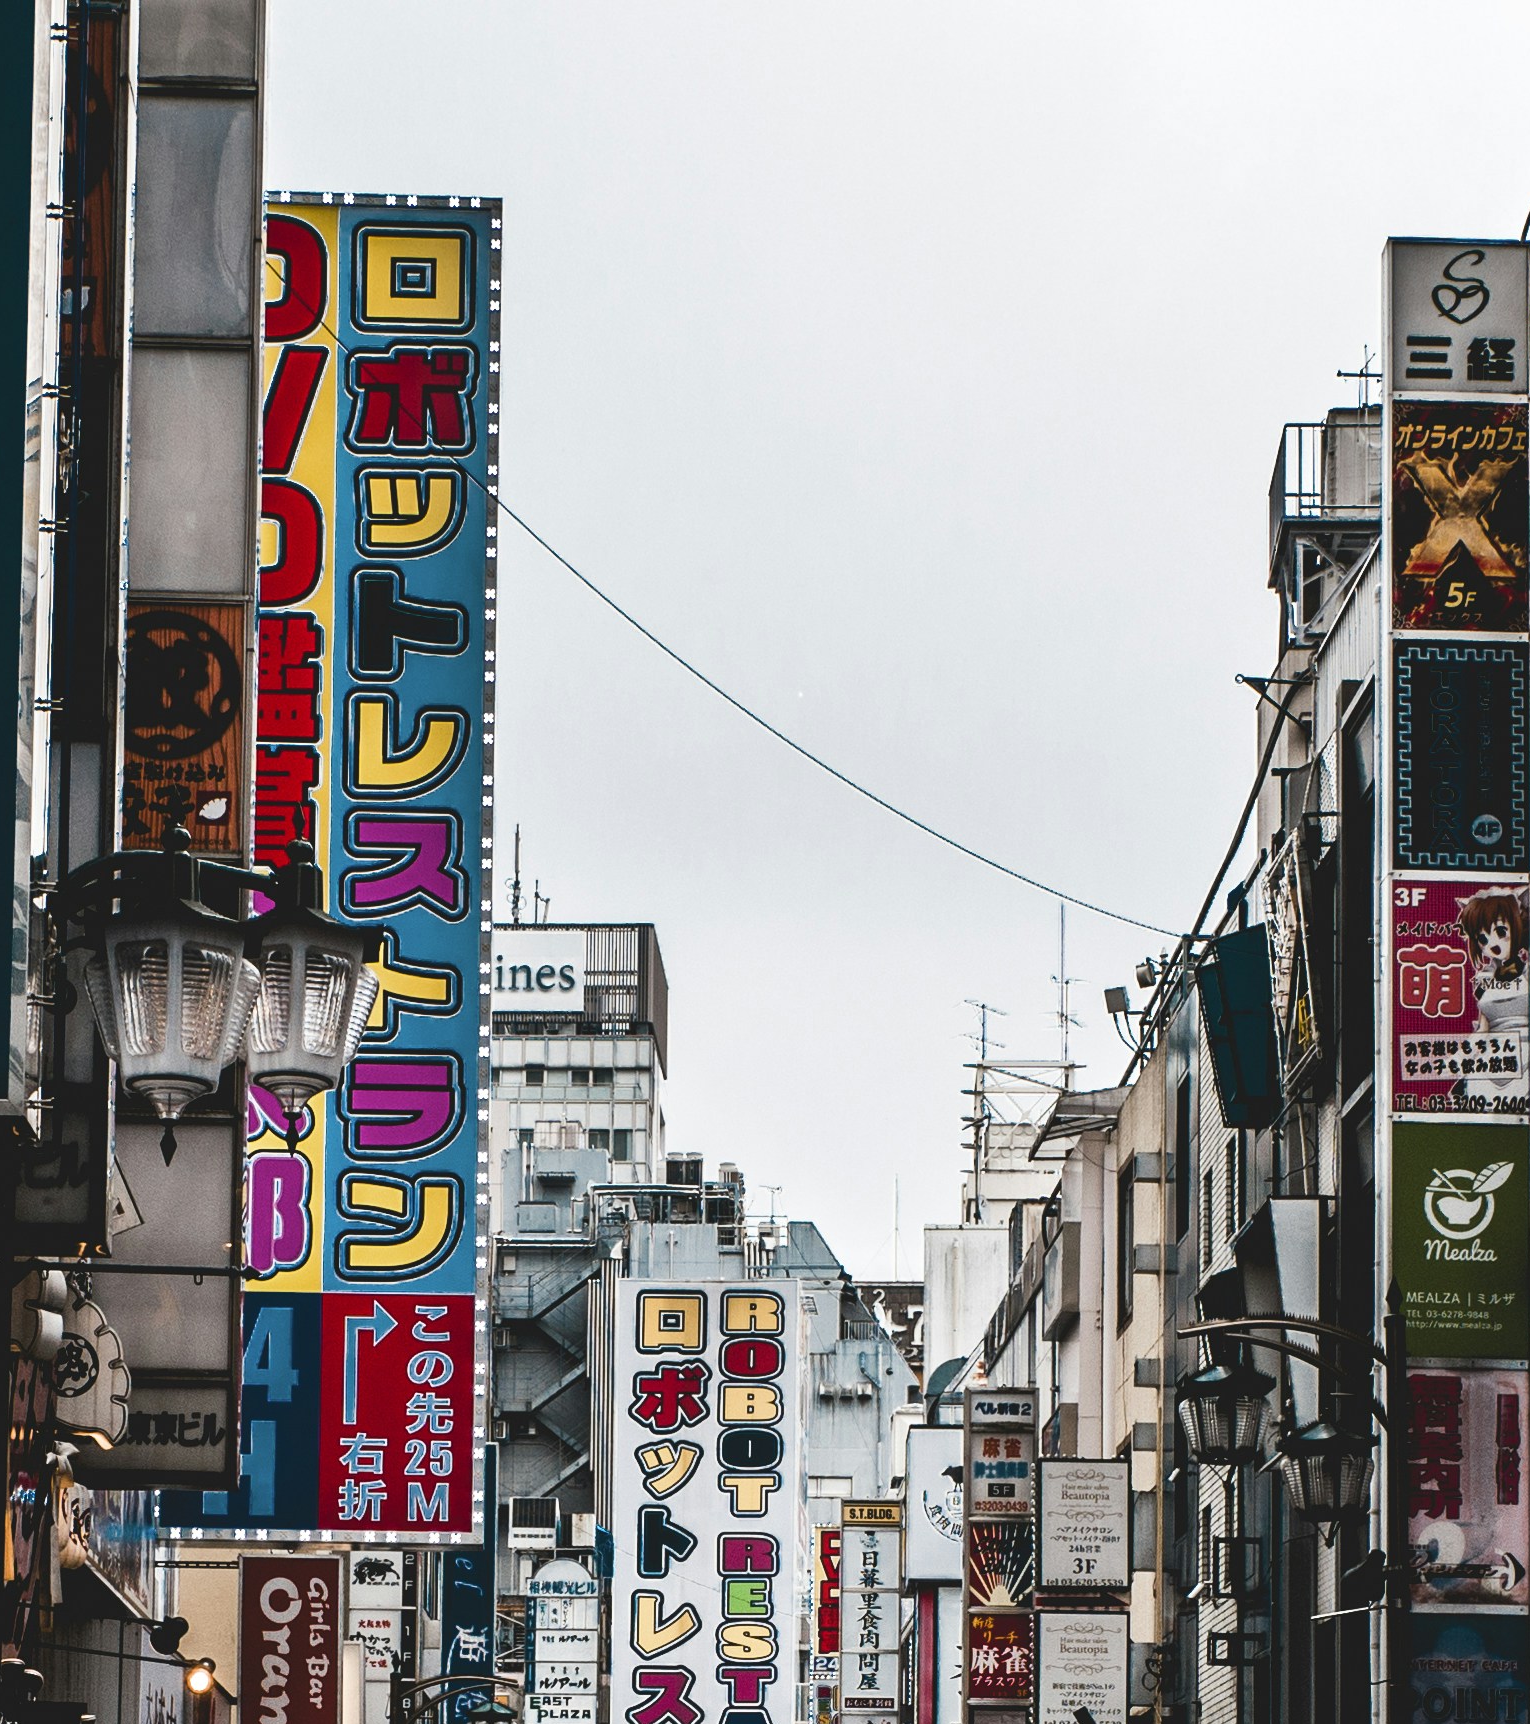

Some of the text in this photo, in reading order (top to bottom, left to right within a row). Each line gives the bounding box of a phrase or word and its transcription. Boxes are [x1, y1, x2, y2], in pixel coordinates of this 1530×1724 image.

[1406, 336, 1516, 381] 三経
[1395, 422, 1527, 452] オンラインカフェ
[1444, 582, 1477, 609] 5F
[1473, 821, 1501, 838] 4F
[1394, 887, 1427, 907] 3F
[494, 954, 576, 993] ines
[1396, 944, 1468, 1018] 萌
[1404, 1038, 1516, 1058] お客様はもちろん
[1404, 1056, 1518, 1075] 女の子も飲み放題
[1423, 1238, 1498, 1263] Mealza
[1405, 1291, 1515, 1305] MEALZA ミルザ
[1406, 1309, 1490, 1319] TEL 03-6278-9848
[405, 1304, 455, 1523] この先25M
[715, 1289, 786, 1519] ROBOT
[982, 1437, 1022, 1459] 麻雀
[337, 1432, 389, 1522] 右折
[982, 1501, 1028, 1512] 3203-0439
[1061, 1490, 1110, 1504] Beautopia
[849, 1508, 896, 1520] S.T.BLDG.
[1073, 1558, 1098, 1574] 3F
[857, 1550, 884, 1691] 日暮里食肉問屋
[970, 1645, 1030, 1675] 麻雀
[1060, 1644, 1110, 1657] Beautopia
[306, 1653, 331, 1710] Bar
[539, 1677, 592, 1690] ルノアール
[529, 1696, 572, 1710] EAST
[537, 1709, 591, 1723] PLAZA
